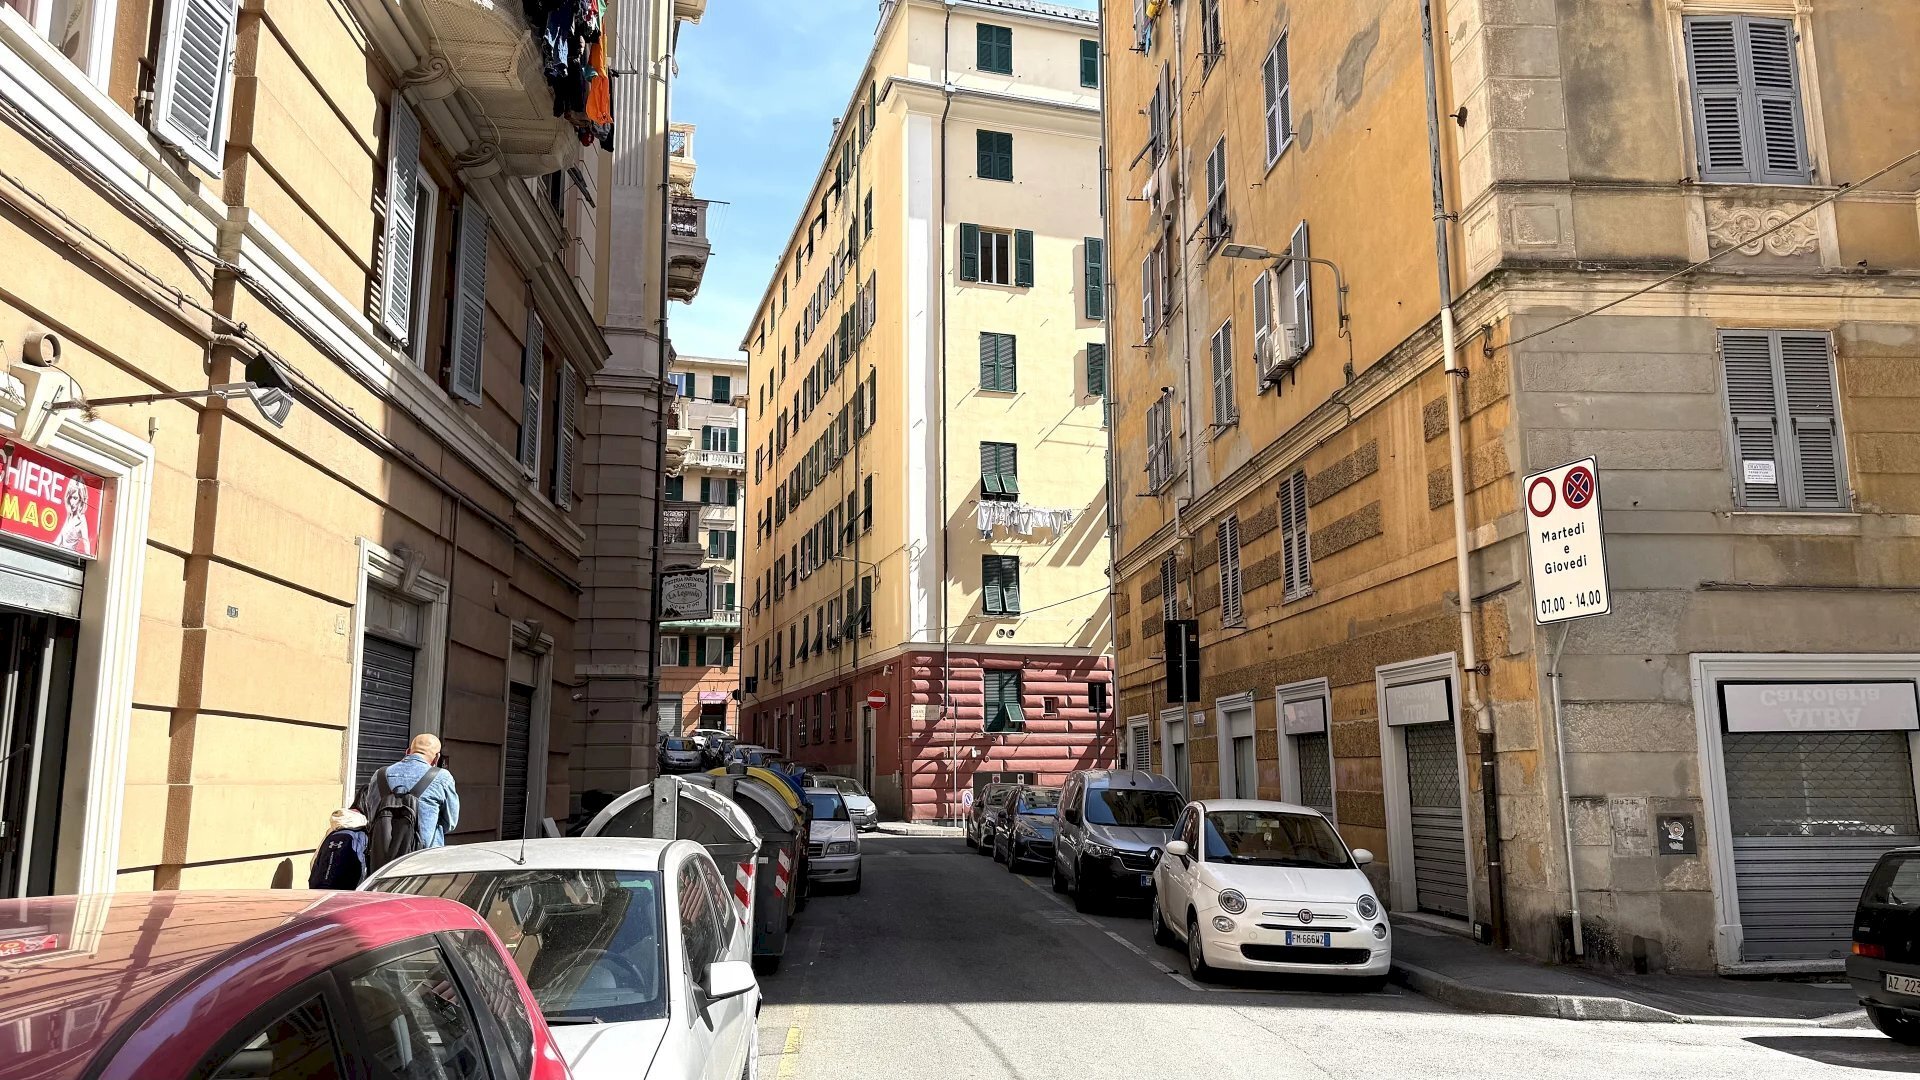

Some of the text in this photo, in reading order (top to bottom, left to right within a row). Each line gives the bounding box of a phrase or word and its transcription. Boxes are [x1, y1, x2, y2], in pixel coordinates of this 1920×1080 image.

[1, 492, 58, 532] MAO
[1563, 544, 1570, 554] e
[1576, 589, 1601, 608] 14.00
[1888, 976, 1899, 990] AZ
